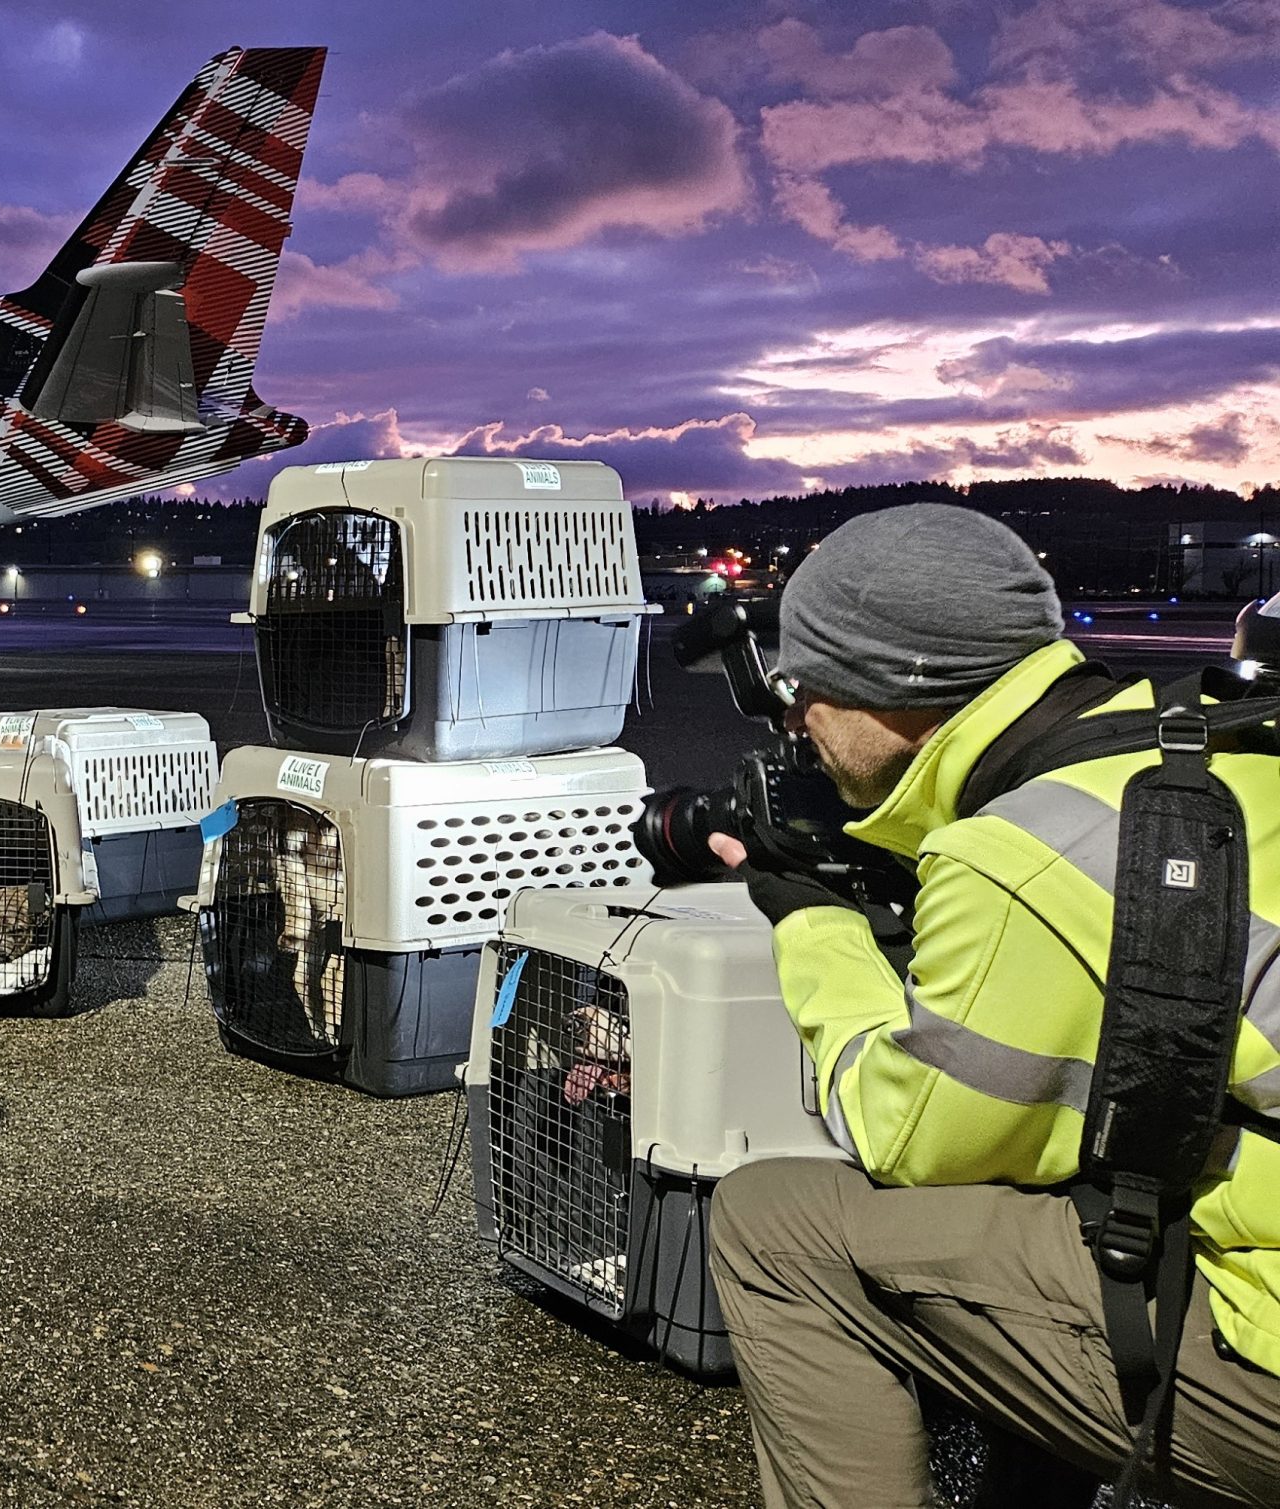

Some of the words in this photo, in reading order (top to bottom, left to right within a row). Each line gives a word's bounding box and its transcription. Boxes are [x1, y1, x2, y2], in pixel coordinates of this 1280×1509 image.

[526, 470, 559, 484] ANIMALS
[293, 760, 316, 776] LIVE
[280, 772, 322, 792] ANIMALS
